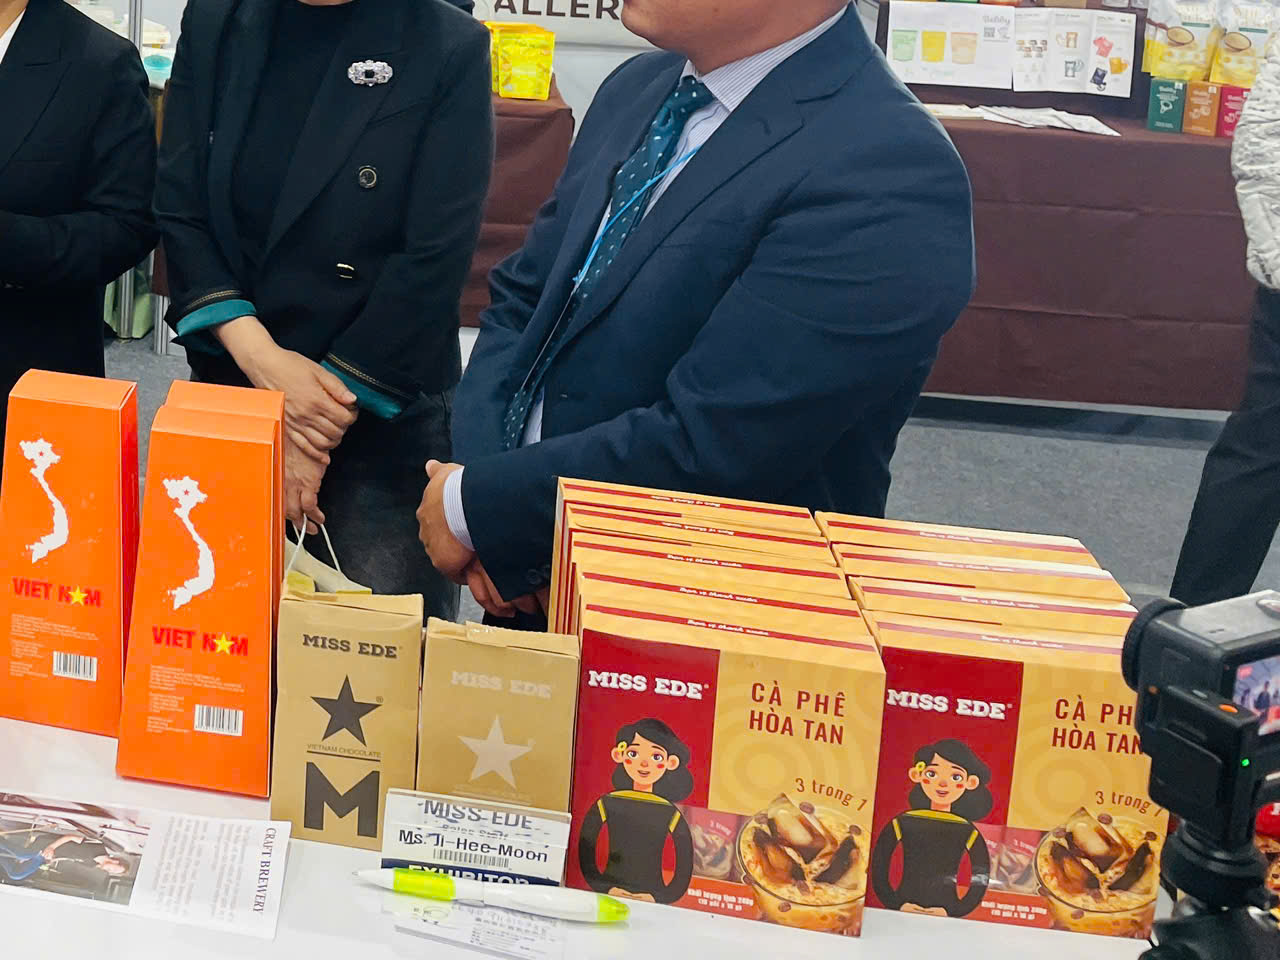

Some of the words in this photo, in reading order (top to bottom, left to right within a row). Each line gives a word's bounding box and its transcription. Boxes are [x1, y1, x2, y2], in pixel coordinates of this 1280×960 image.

[12, 577, 53, 601] VIET
[152, 625, 196, 649] VIET
[302, 633, 351, 653] MISS
[358, 642, 398, 659] EDE
[451, 669, 503, 691] MISS
[510, 678, 552, 700] EDE
[587, 669, 647, 692] MISS
[654, 677, 703, 700] EDE
[751, 680, 782, 707] CÀ
[797, 690, 847, 718] PHÊ
[886, 688, 949, 713] MISS
[956, 697, 1006, 720] EDE
[1055, 695, 1085, 721] CÀ
[749, 705, 794, 737] HÒA
[803, 719, 845, 745] TAN
[1051, 723, 1096, 751] HÒA
[306, 743, 338, 753] VIETNAM
[303, 762, 380, 838] M
[794, 777, 806, 793] 3
[812, 780, 854, 807] trong
[1095, 790, 1105, 806] 3
[1111, 792, 1152, 815] trong
[261, 827, 277, 859] CRAFT
[399, 829, 427, 846] Ms.
[252, 860, 272, 913] BREWERY
